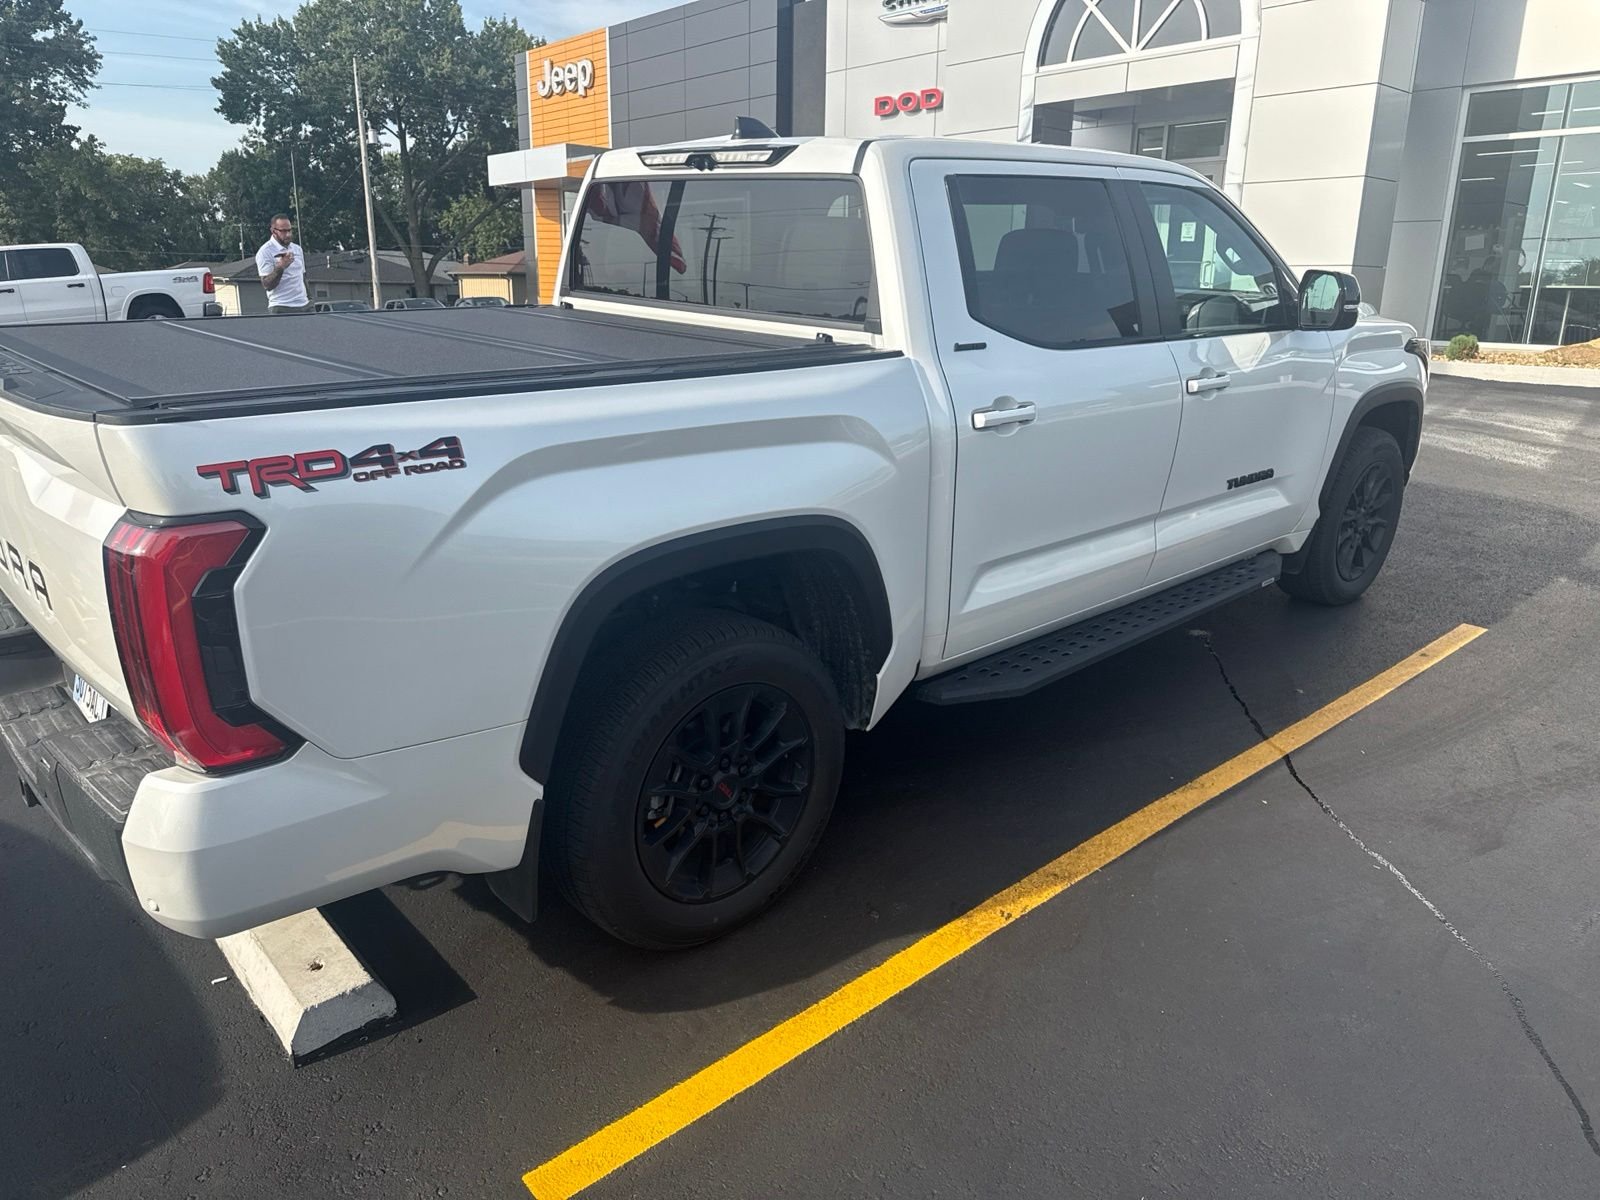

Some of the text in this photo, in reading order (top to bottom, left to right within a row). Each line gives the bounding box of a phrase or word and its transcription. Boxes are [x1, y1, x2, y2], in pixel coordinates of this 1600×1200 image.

[536, 58, 595, 99] Jeep
[196, 436, 465, 499] TRD 4x4
[353, 459, 467, 482] OFF ROAD
